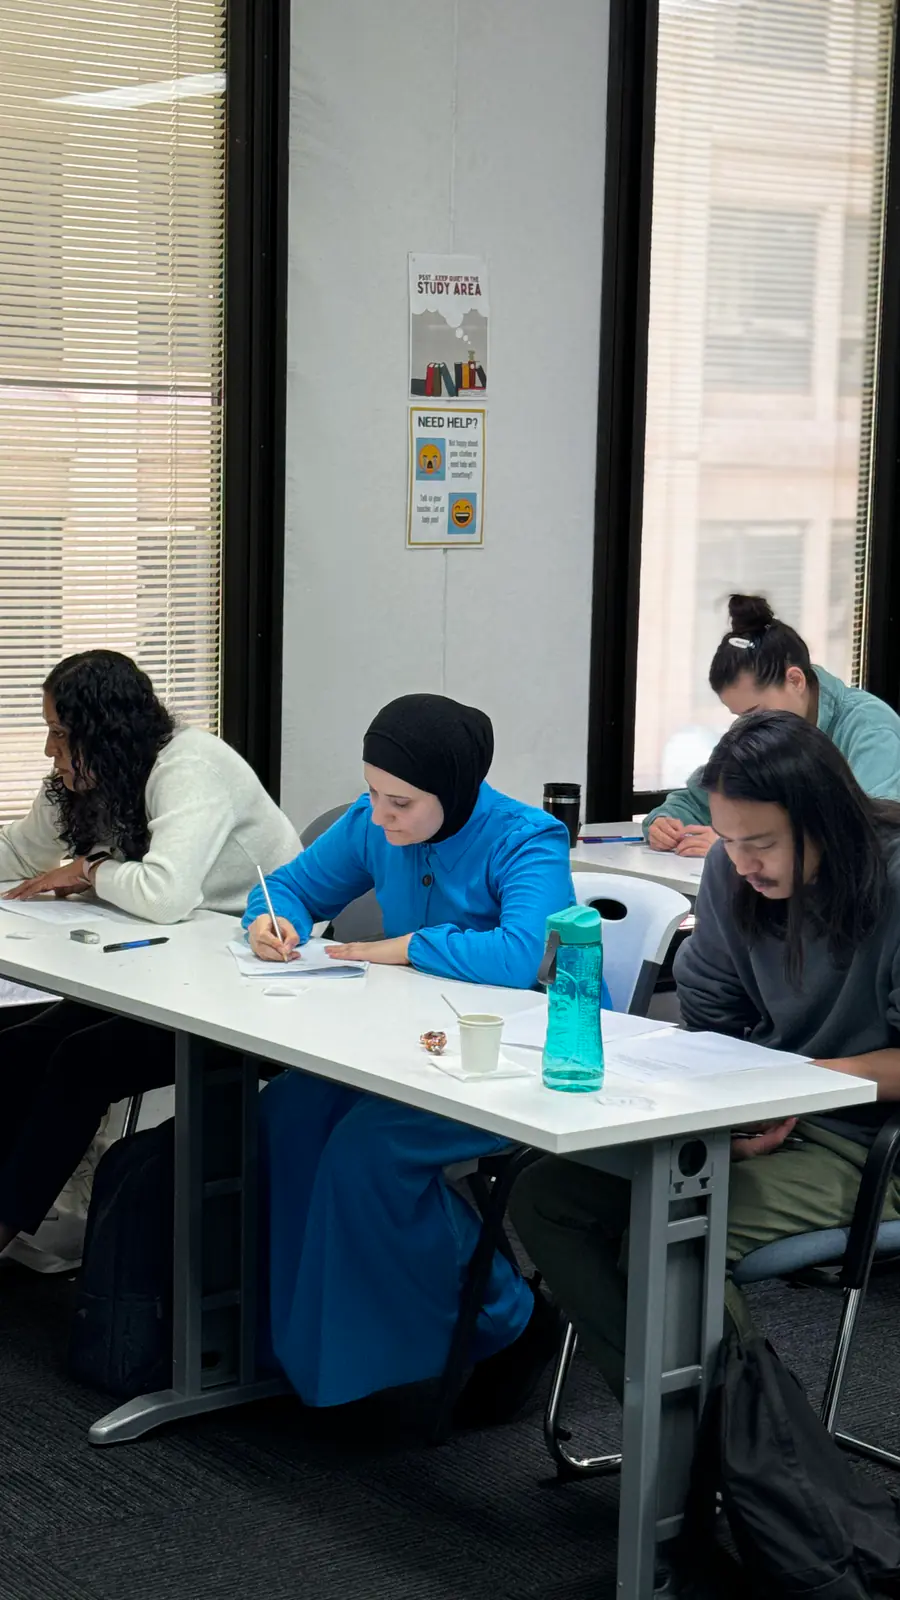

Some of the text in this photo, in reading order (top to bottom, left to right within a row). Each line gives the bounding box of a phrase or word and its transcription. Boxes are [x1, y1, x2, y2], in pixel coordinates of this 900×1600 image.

[418, 282, 482, 296] STUDY AREA
[418, 416, 478, 429] NEED HELP?
